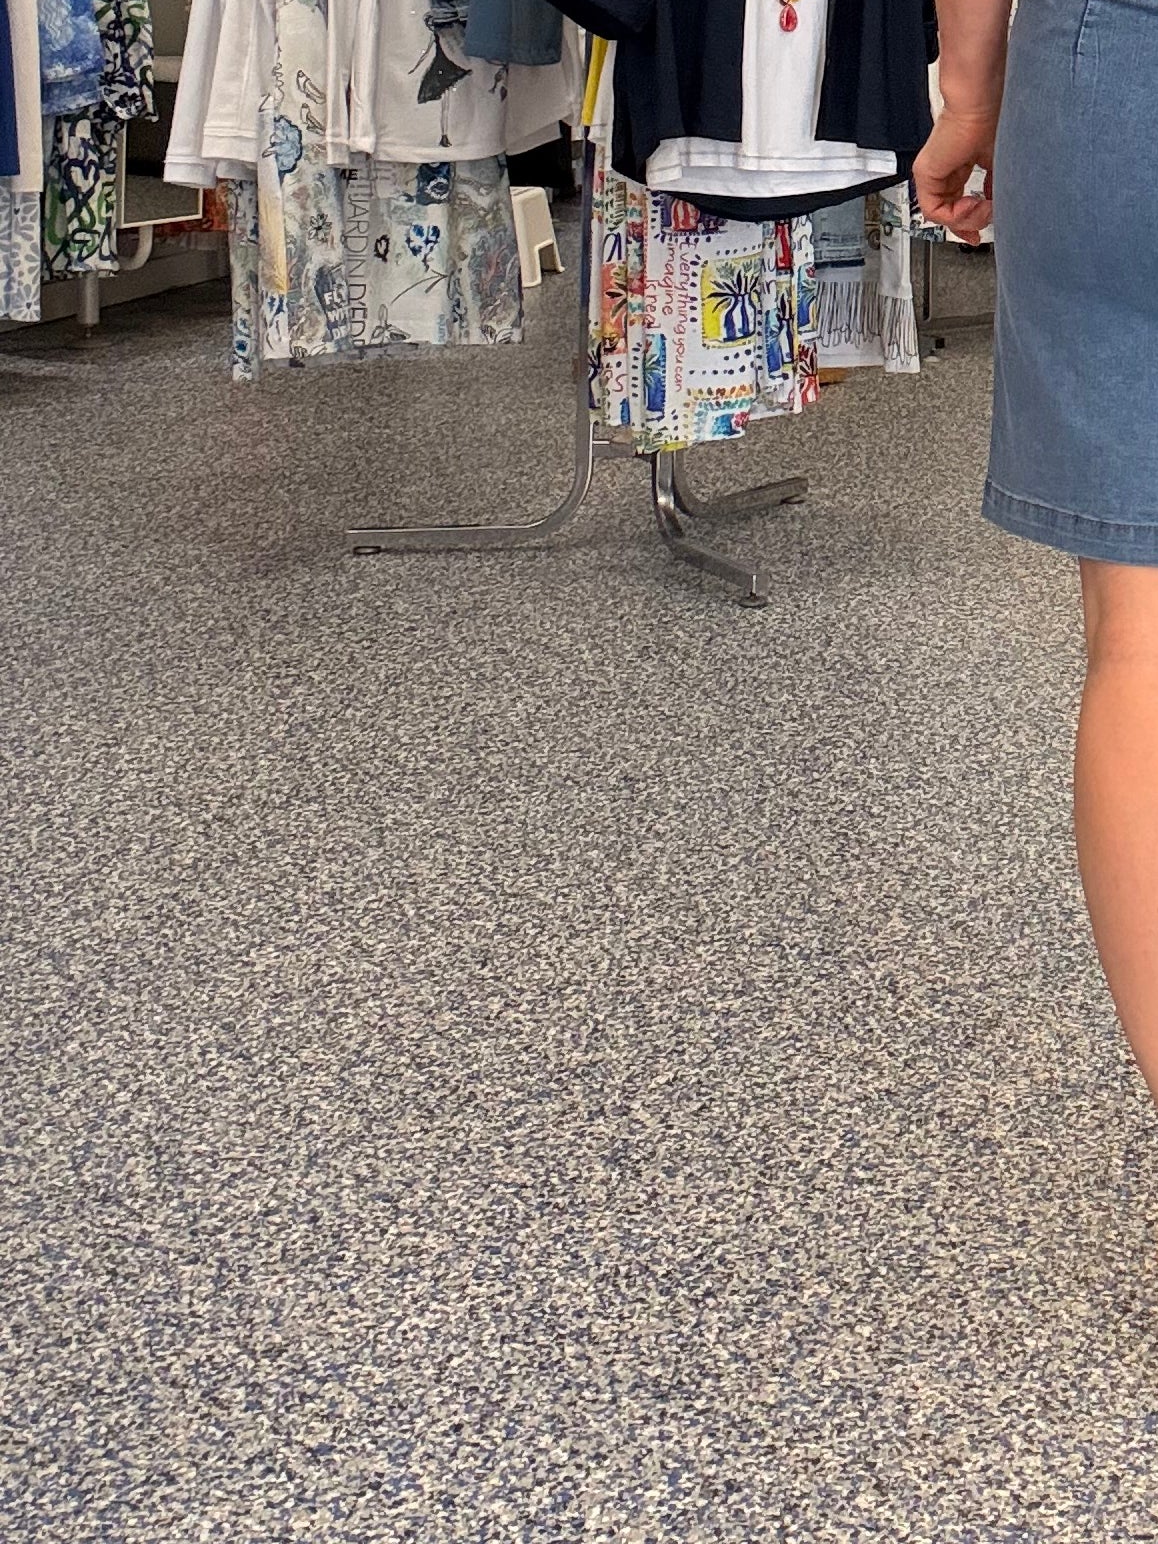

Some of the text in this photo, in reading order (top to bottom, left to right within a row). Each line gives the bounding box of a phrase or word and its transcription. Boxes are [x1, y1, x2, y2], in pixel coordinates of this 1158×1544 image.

[345, 195, 369, 279] JARDIN
[657, 242, 677, 316] imagine
[674, 240, 697, 335] Everything
